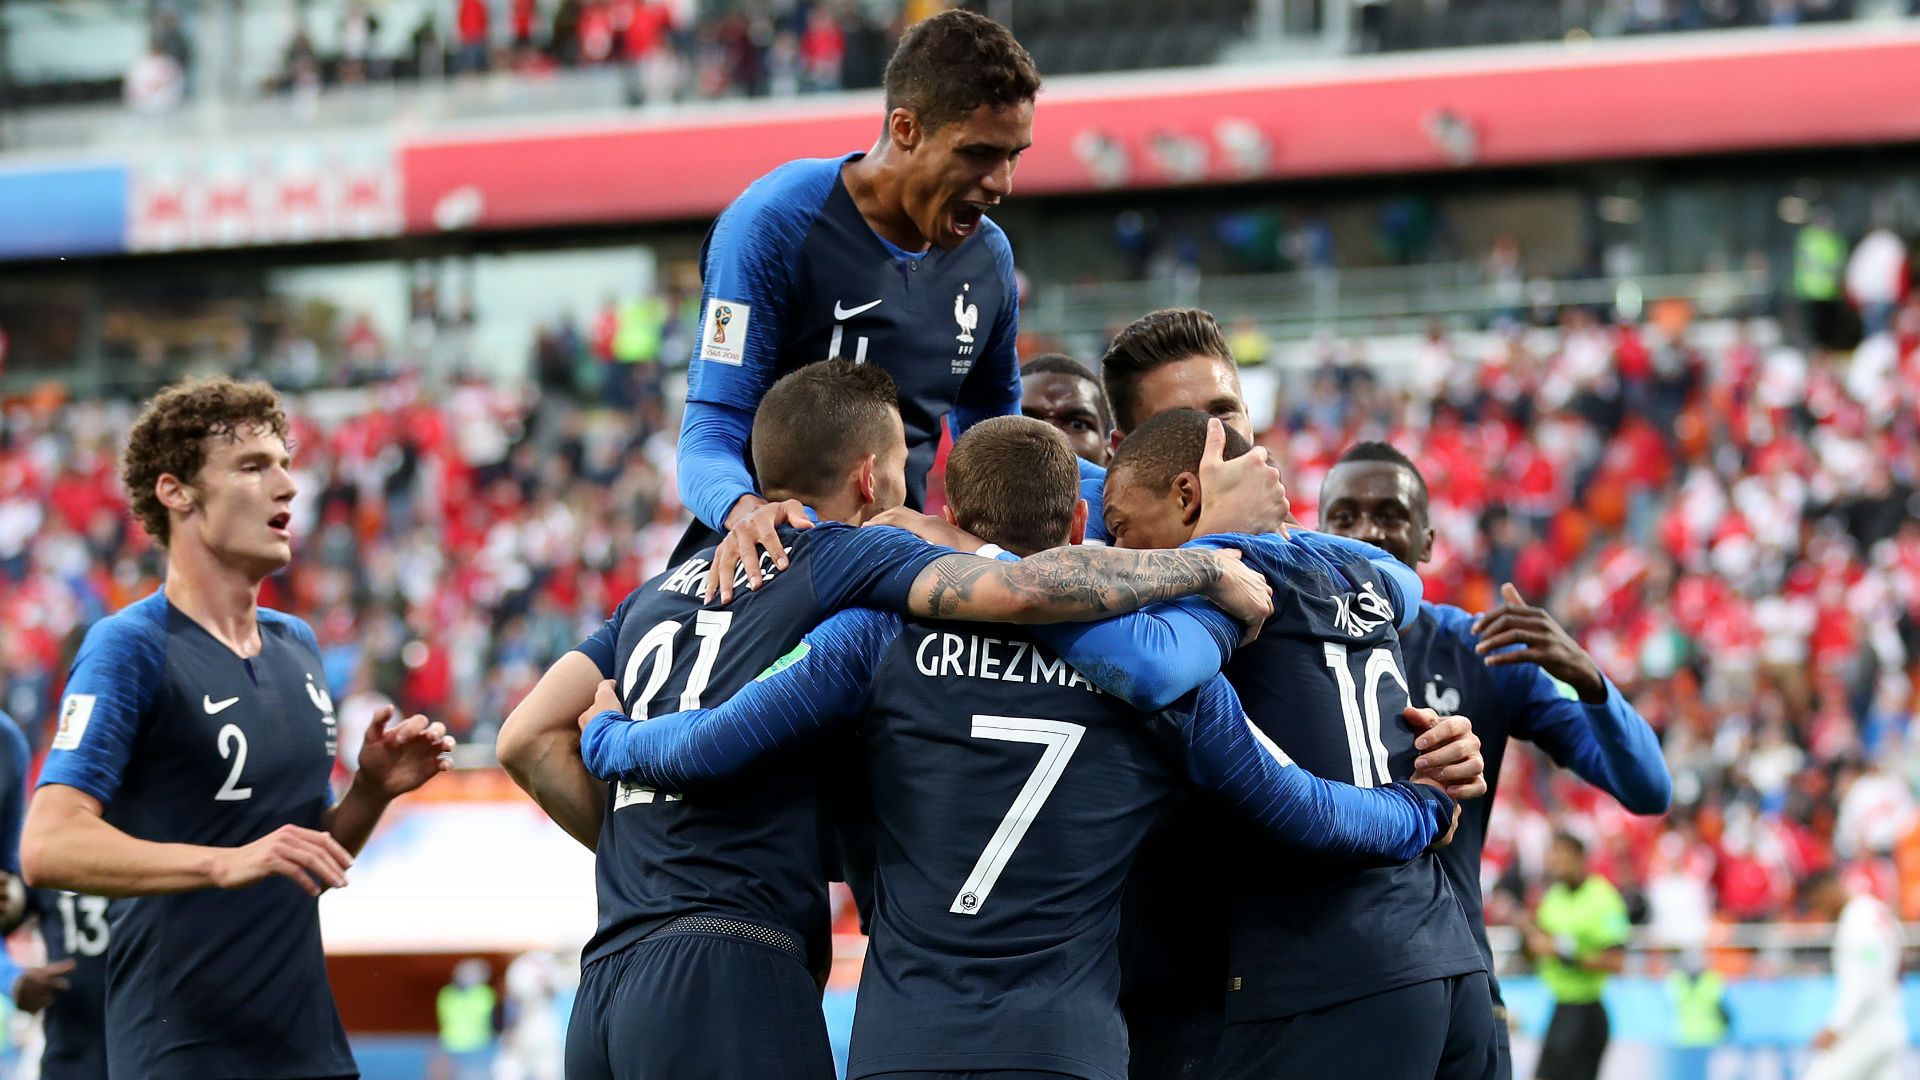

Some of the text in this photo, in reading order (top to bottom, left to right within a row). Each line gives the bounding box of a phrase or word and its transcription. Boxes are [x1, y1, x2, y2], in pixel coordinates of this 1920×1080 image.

[614, 609, 733, 813] 21
[916, 632, 1103, 694] GRIEZMA
[1323, 641, 1413, 789] 10
[214, 723, 252, 801] 2
[949, 714, 1087, 916] 7
[57, 890, 111, 957] 13
